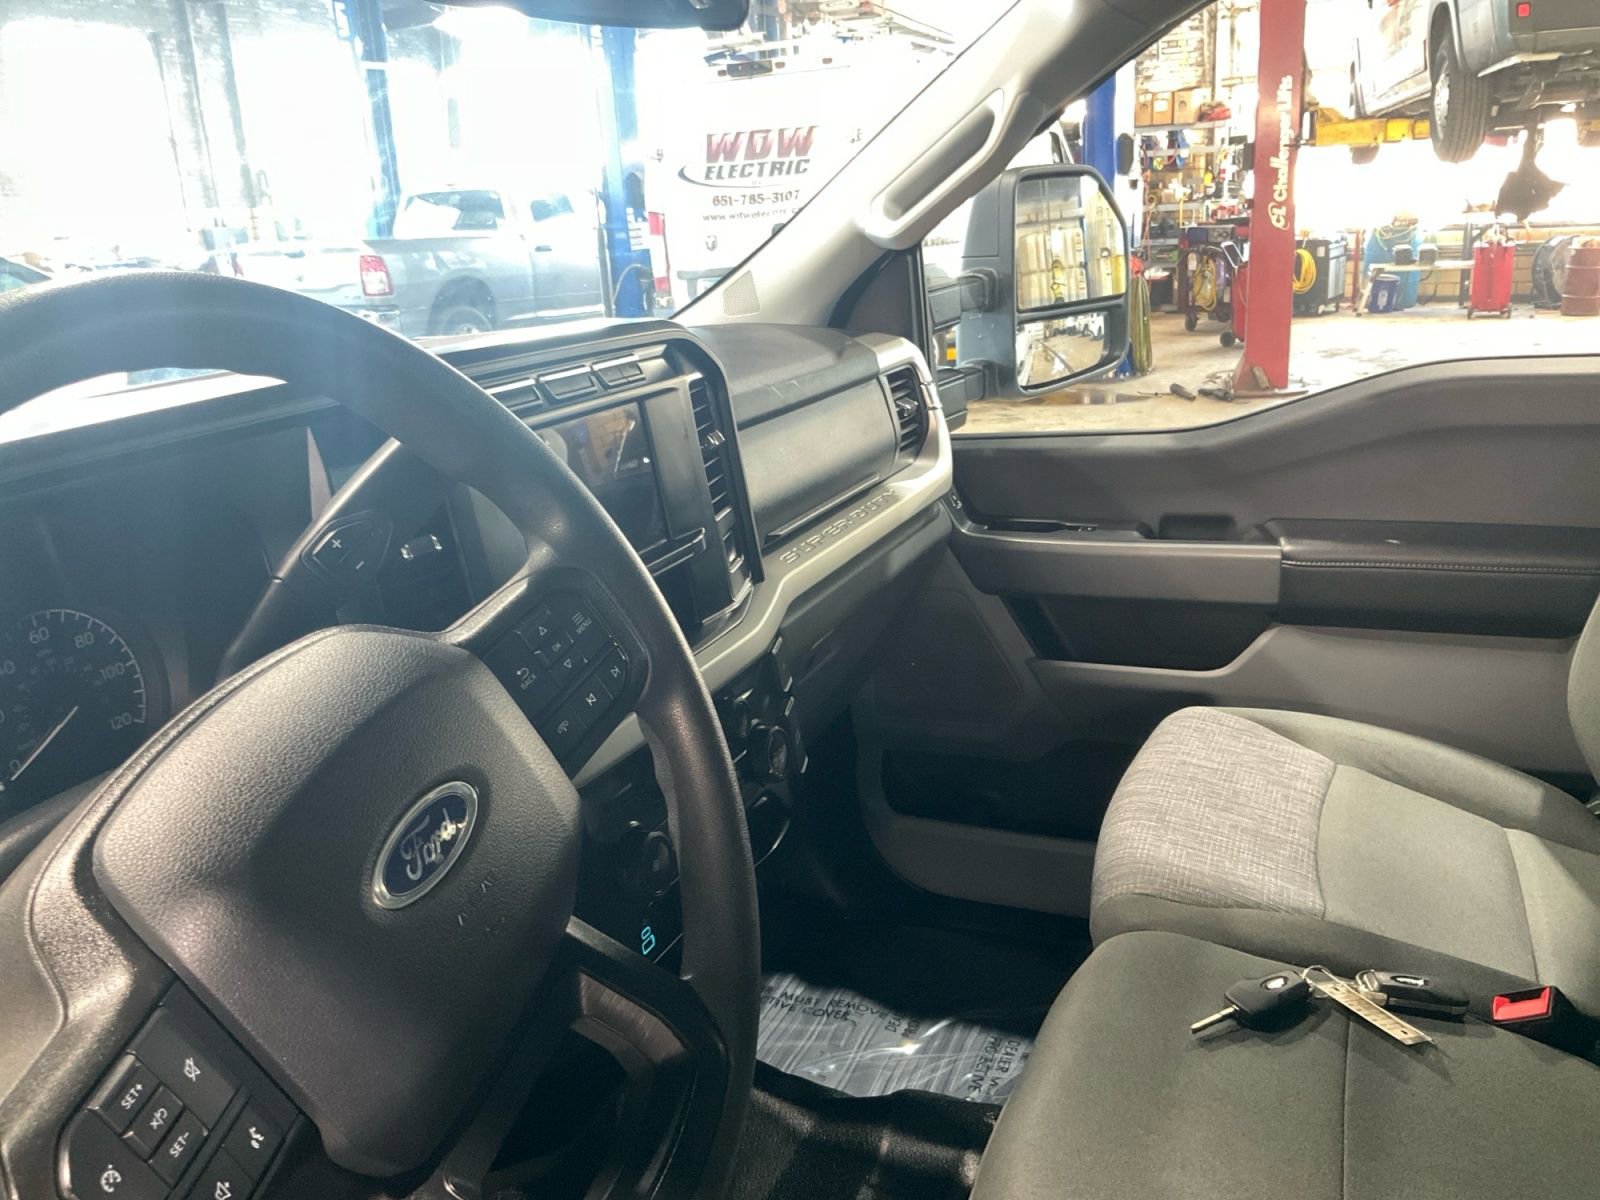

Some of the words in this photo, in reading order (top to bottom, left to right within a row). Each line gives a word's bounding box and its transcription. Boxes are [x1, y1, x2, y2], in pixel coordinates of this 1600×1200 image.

[1269, 112, 1295, 202] Challenger
[704, 159, 811, 180] ELECTRIC
[712, 190, 800, 206] 651-785-3107
[576, 617, 592, 635] MENU
[29, 627, 50, 645] 60
[74, 631, 95, 649] 80
[99, 662, 126, 681] 100
[109, 712, 133, 731] 120
[401, 808, 460, 881] Ford
[802, 1006, 851, 1021] COVER
[120, 1083, 143, 1110] SET+
[169, 1131, 190, 1158] SET-
